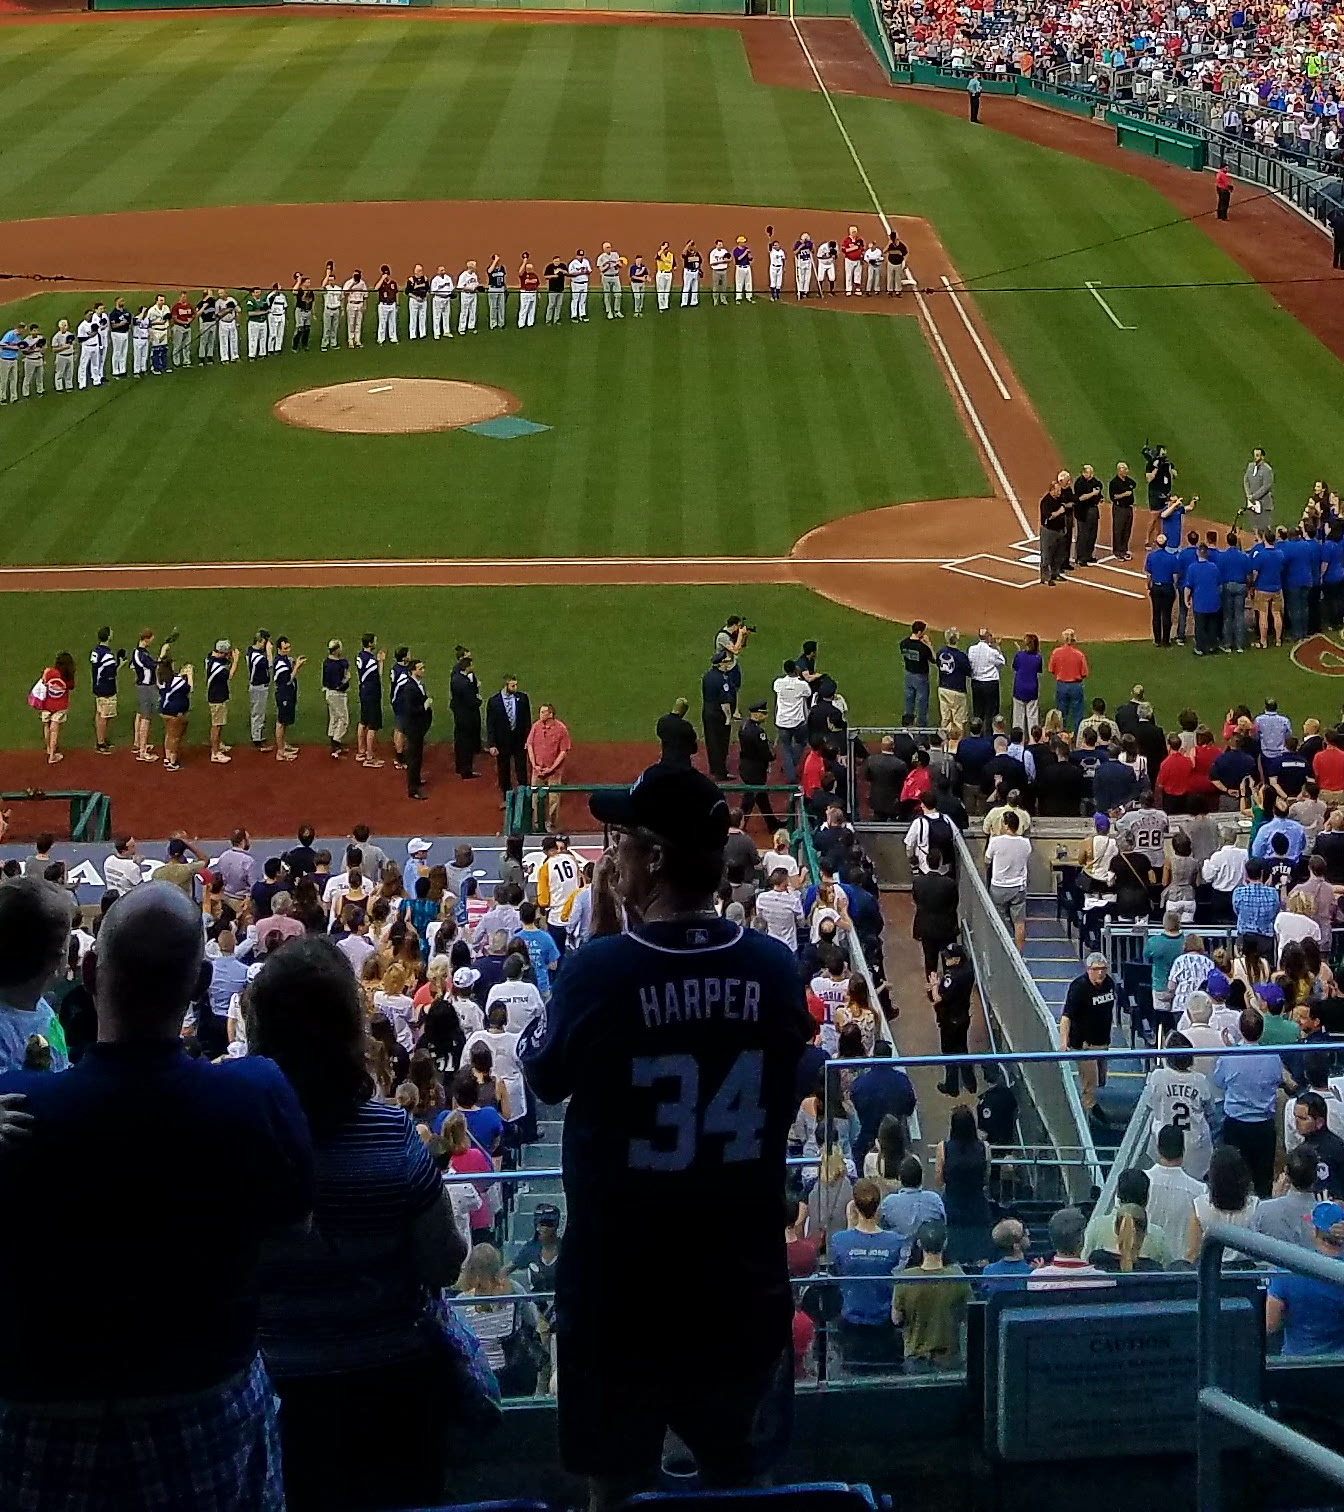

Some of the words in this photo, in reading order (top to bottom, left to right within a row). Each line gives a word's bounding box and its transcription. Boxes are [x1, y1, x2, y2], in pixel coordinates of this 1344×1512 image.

[1138, 829, 1162, 848] 28
[553, 856, 576, 884] 16
[639, 977, 761, 1028] HARPER
[1092, 992, 1115, 1006] POLICE
[1166, 1084, 1199, 1100] JETER
[628, 1049, 767, 1172] 34
[1172, 1101, 1191, 1131] 2
